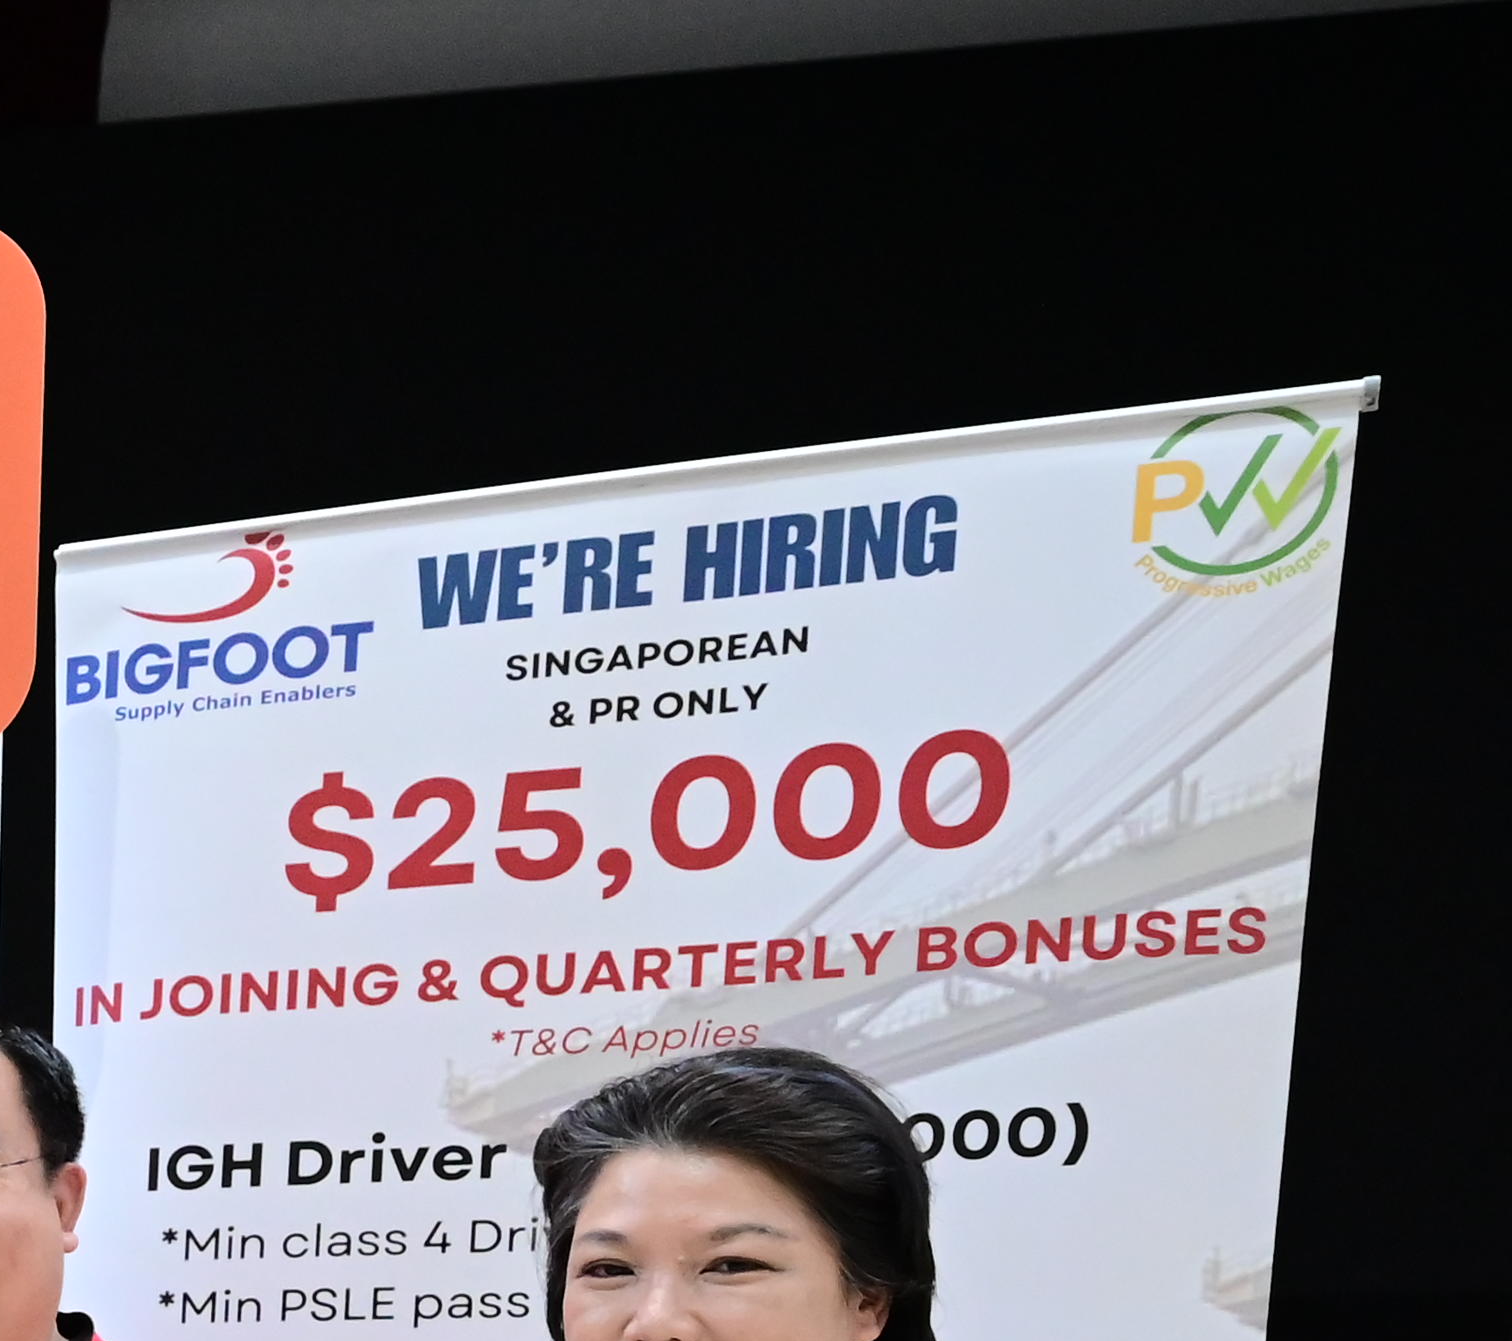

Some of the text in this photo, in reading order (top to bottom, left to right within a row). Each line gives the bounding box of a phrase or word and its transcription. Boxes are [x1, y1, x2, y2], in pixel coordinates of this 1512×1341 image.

[417, 494, 960, 630] WE'RE HIRING
[1259, 537, 1332, 588] Wages
[65, 620, 375, 706] BIGFOOT
[505, 627, 810, 681] SINGAPOREAN
[114, 682, 357, 722] Supply Chain Enablers
[549, 683, 770, 728] & PR ONLY
[284, 728, 1012, 914] $25,000
[74, 907, 1268, 1028] IN JOINING & QUARTERLY BONUSES
[601, 1020, 760, 1066] Applies
[147, 1132, 507, 1191] IGH Driver
[282, 1223, 408, 1258] class
[423, 1222, 451, 1254] 4
[280, 1287, 396, 1322] PSLE
[413, 1291, 531, 1328] pass
